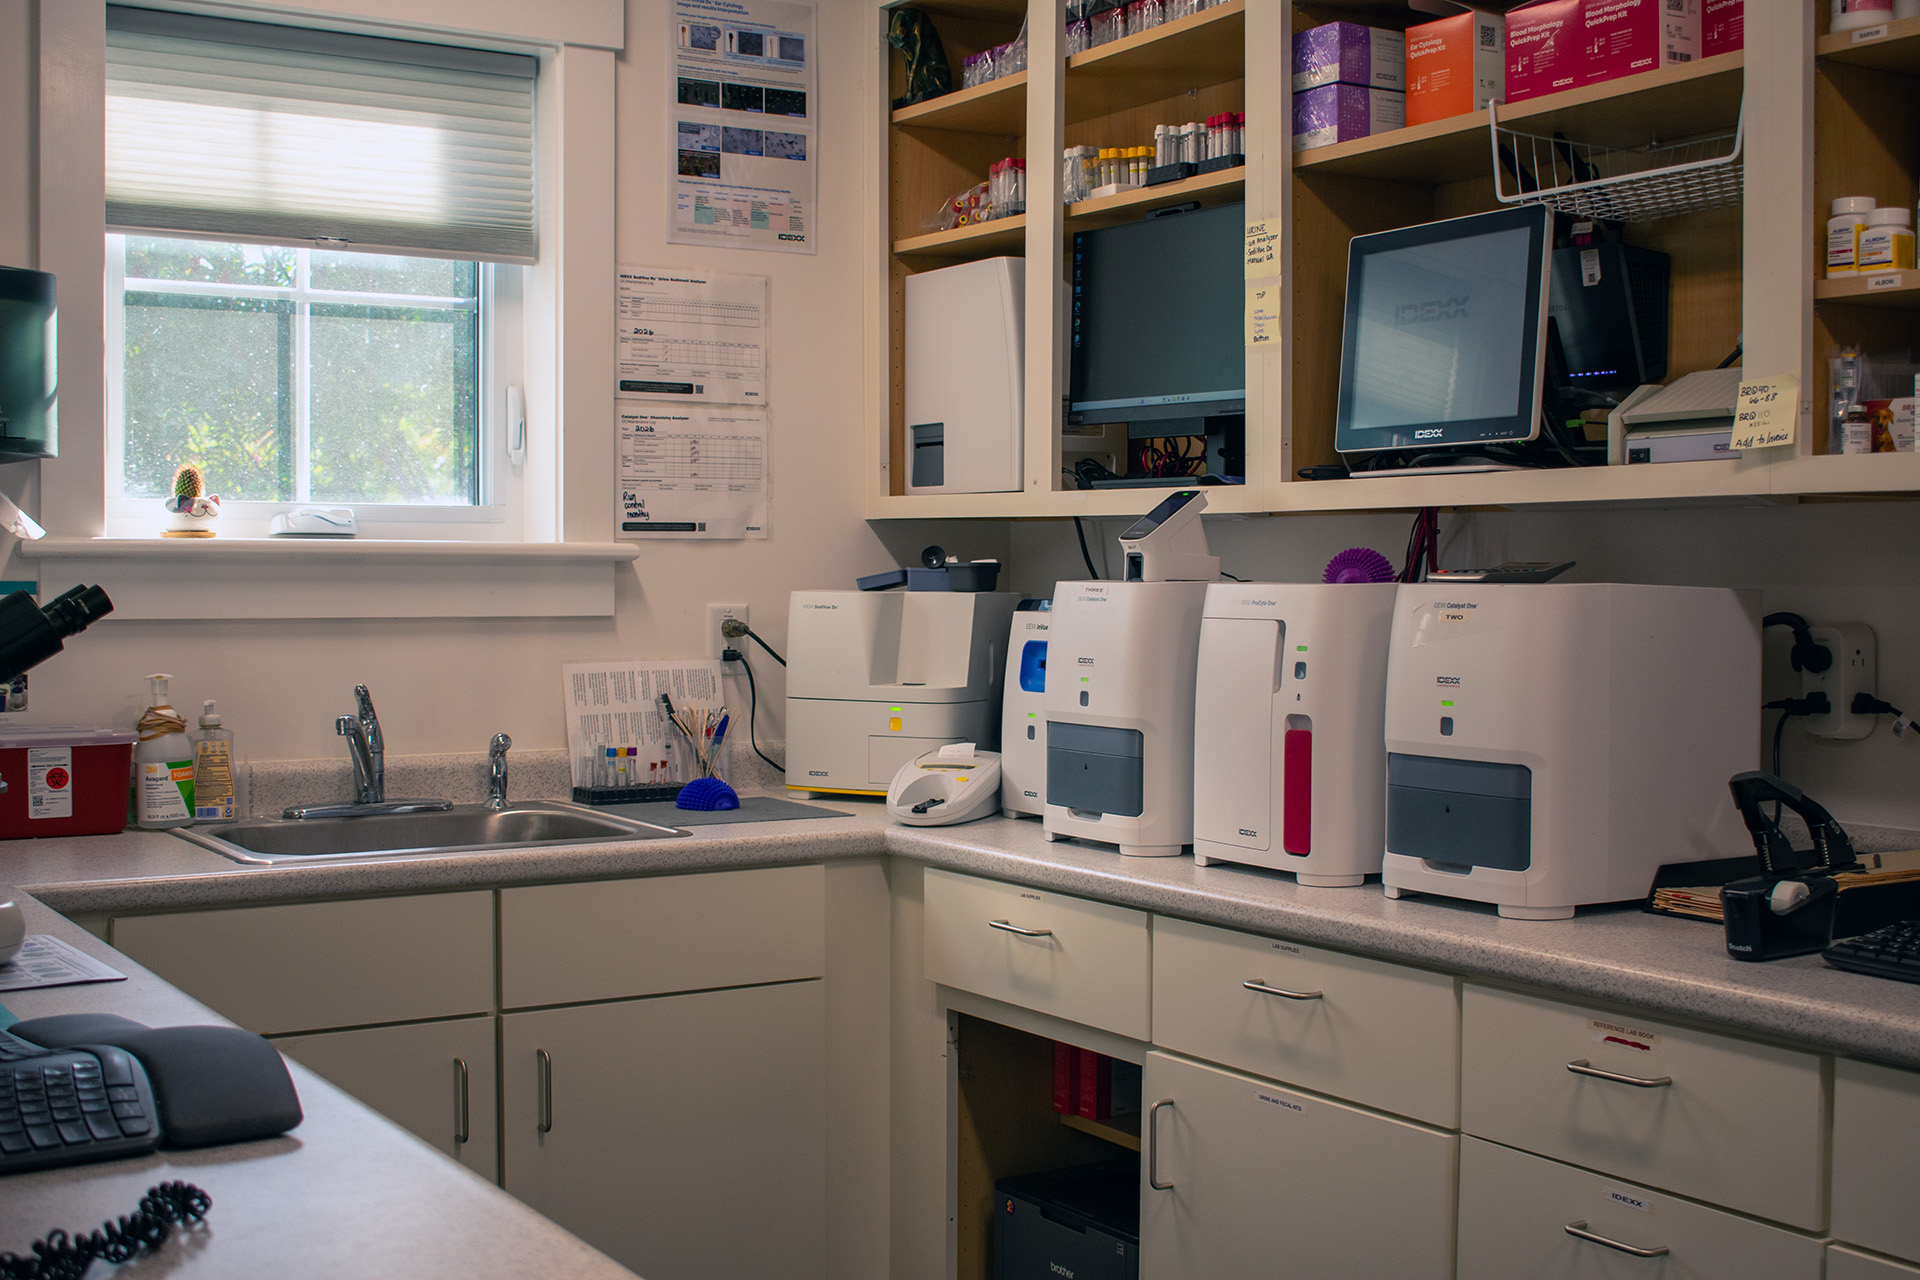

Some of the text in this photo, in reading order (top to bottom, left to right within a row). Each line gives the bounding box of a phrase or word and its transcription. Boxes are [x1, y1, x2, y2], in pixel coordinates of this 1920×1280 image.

[1585, 0, 1642, 18] Blood Morphology
[1706, 0, 1736, 14] QuickPrep
[1585, 14, 1617, 28] QuickPrep
[1510, 20, 1563, 38] Blood Morphology
[1419, 38, 1442, 48] Cytology
[1510, 34, 1540, 48] QuickPrep
[1410, 48, 1437, 60] QuickPrep
[1631, 58, 1652, 68] IDEXX
[1376, 72, 1398, 81] IDEXX
[1553, 77, 1573, 87] IDEXX
[1247, 224, 1266, 234] URINE
[778, 233, 805, 242] IDEXX
[1257, 234, 1278, 244] Analyzer
[1394, 296, 1470, 326] IDEXX
[1415, 428, 1443, 439] IDEXX
[1736, 436, 1753, 448] Add
[1757, 434, 1765, 444] to
[623, 491, 636, 502] Run
[624, 500, 645, 509] control
[626, 510, 650, 521] monthly
[145, 766, 158, 774] 3M
[1239, 828, 1257, 837] IDEXX
[1280, 945, 1299, 954] SUPPLIES
[1728, 942, 1752, 952] Scotch
[1593, 1020, 1625, 1034] REFERENCE
[1638, 1031, 1654, 1040] BOOK
[1280, 1100, 1292, 1108] FECAL
[1612, 1192, 1642, 1208] IDEXX
[1050, 1260, 1074, 1280] brother
